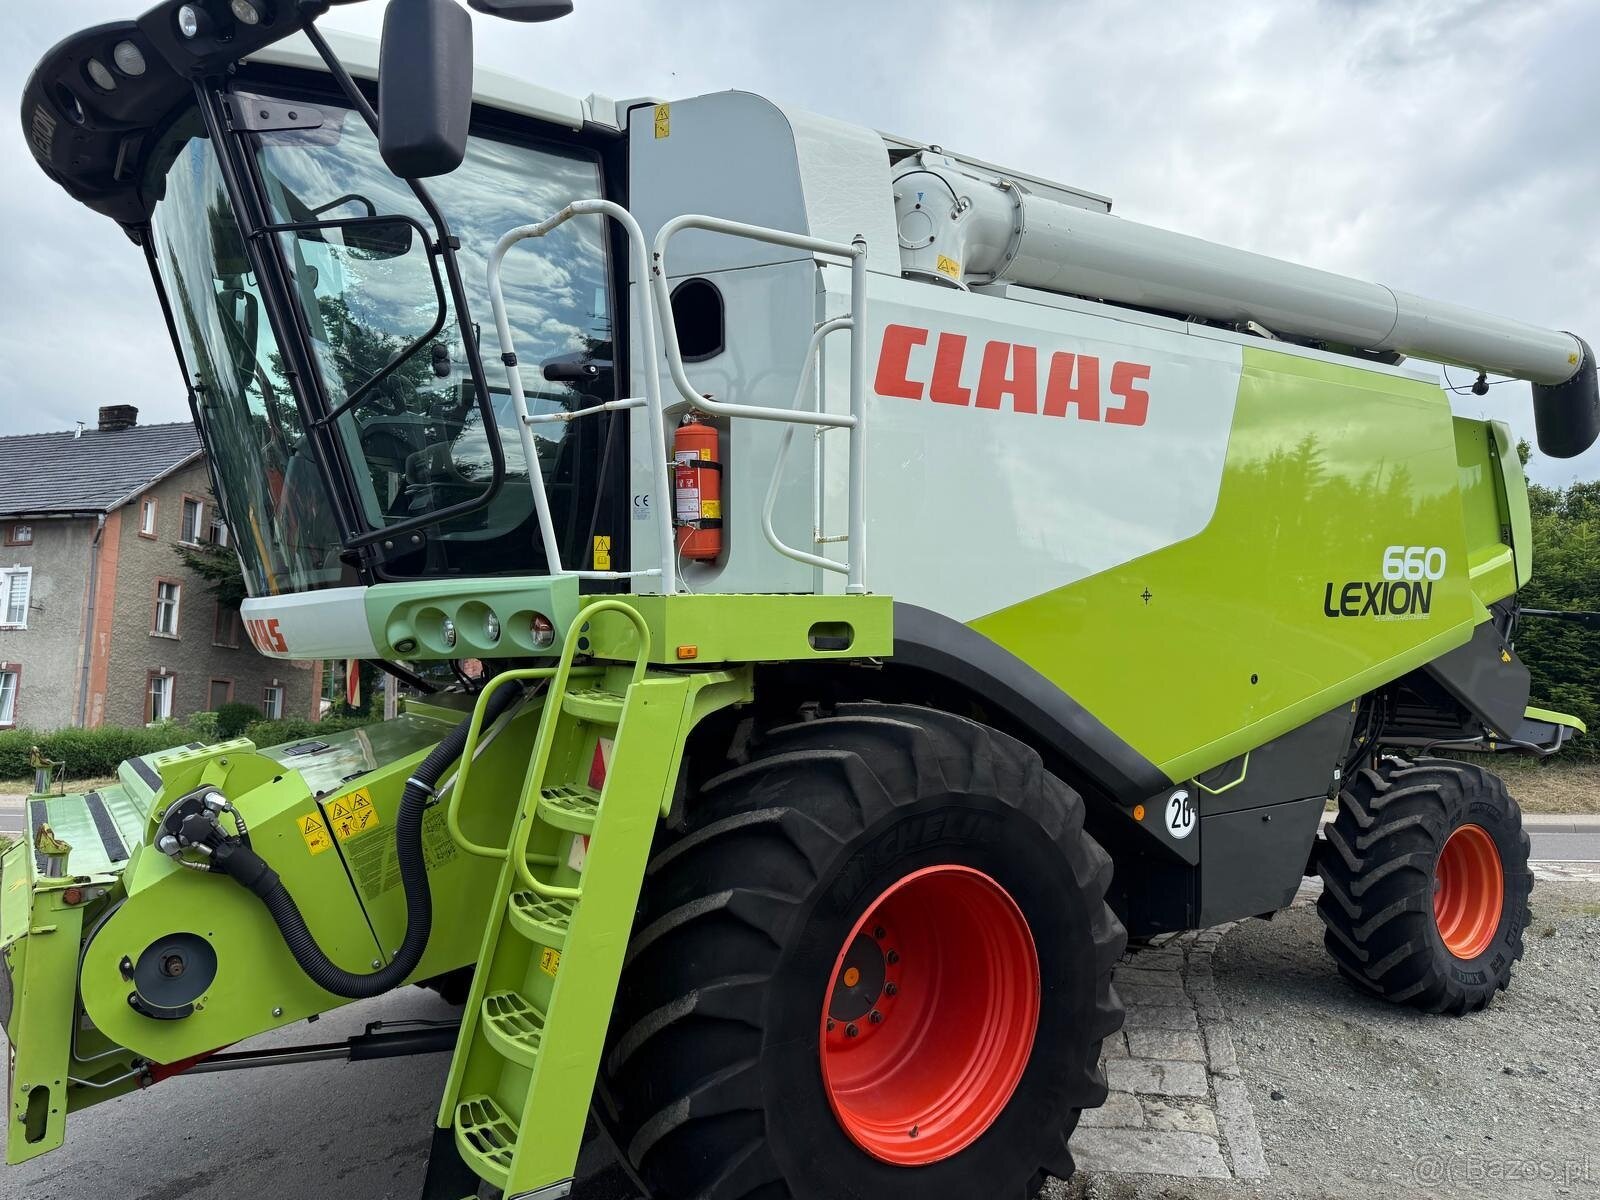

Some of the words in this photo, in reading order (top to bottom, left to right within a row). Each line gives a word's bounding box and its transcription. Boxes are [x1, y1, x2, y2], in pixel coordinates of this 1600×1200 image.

[873, 323, 1151, 427] CLAAS
[1383, 545, 1446, 581] 660
[1324, 581, 1433, 617] LEXION
